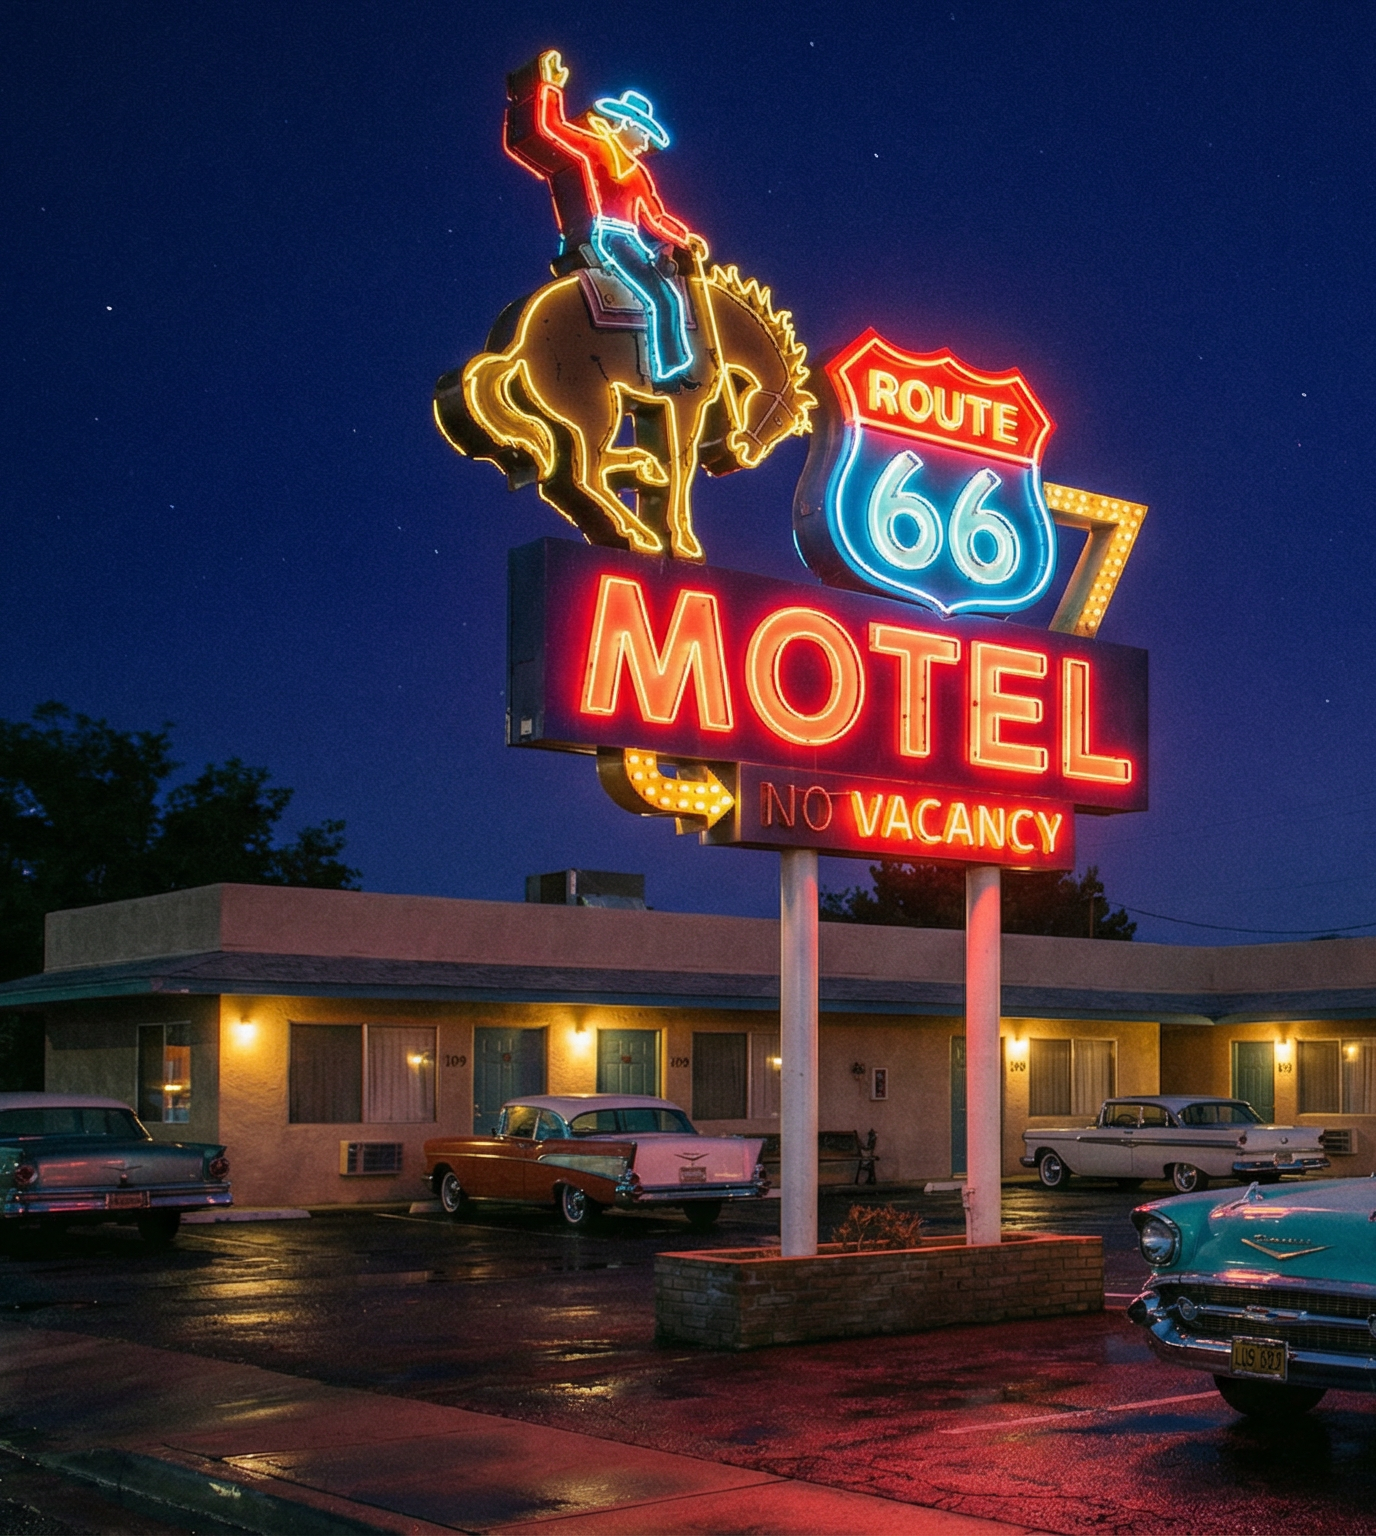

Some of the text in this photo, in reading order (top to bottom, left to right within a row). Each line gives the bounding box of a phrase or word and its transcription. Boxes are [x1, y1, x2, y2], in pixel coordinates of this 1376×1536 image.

[868, 369, 1019, 443] ROUTE
[868, 450, 1021, 584] 66
[581, 575, 1132, 784] MOTEL
[761, 783, 1063, 853] NO VACANCY
[446, 1055, 467, 1067] 109
